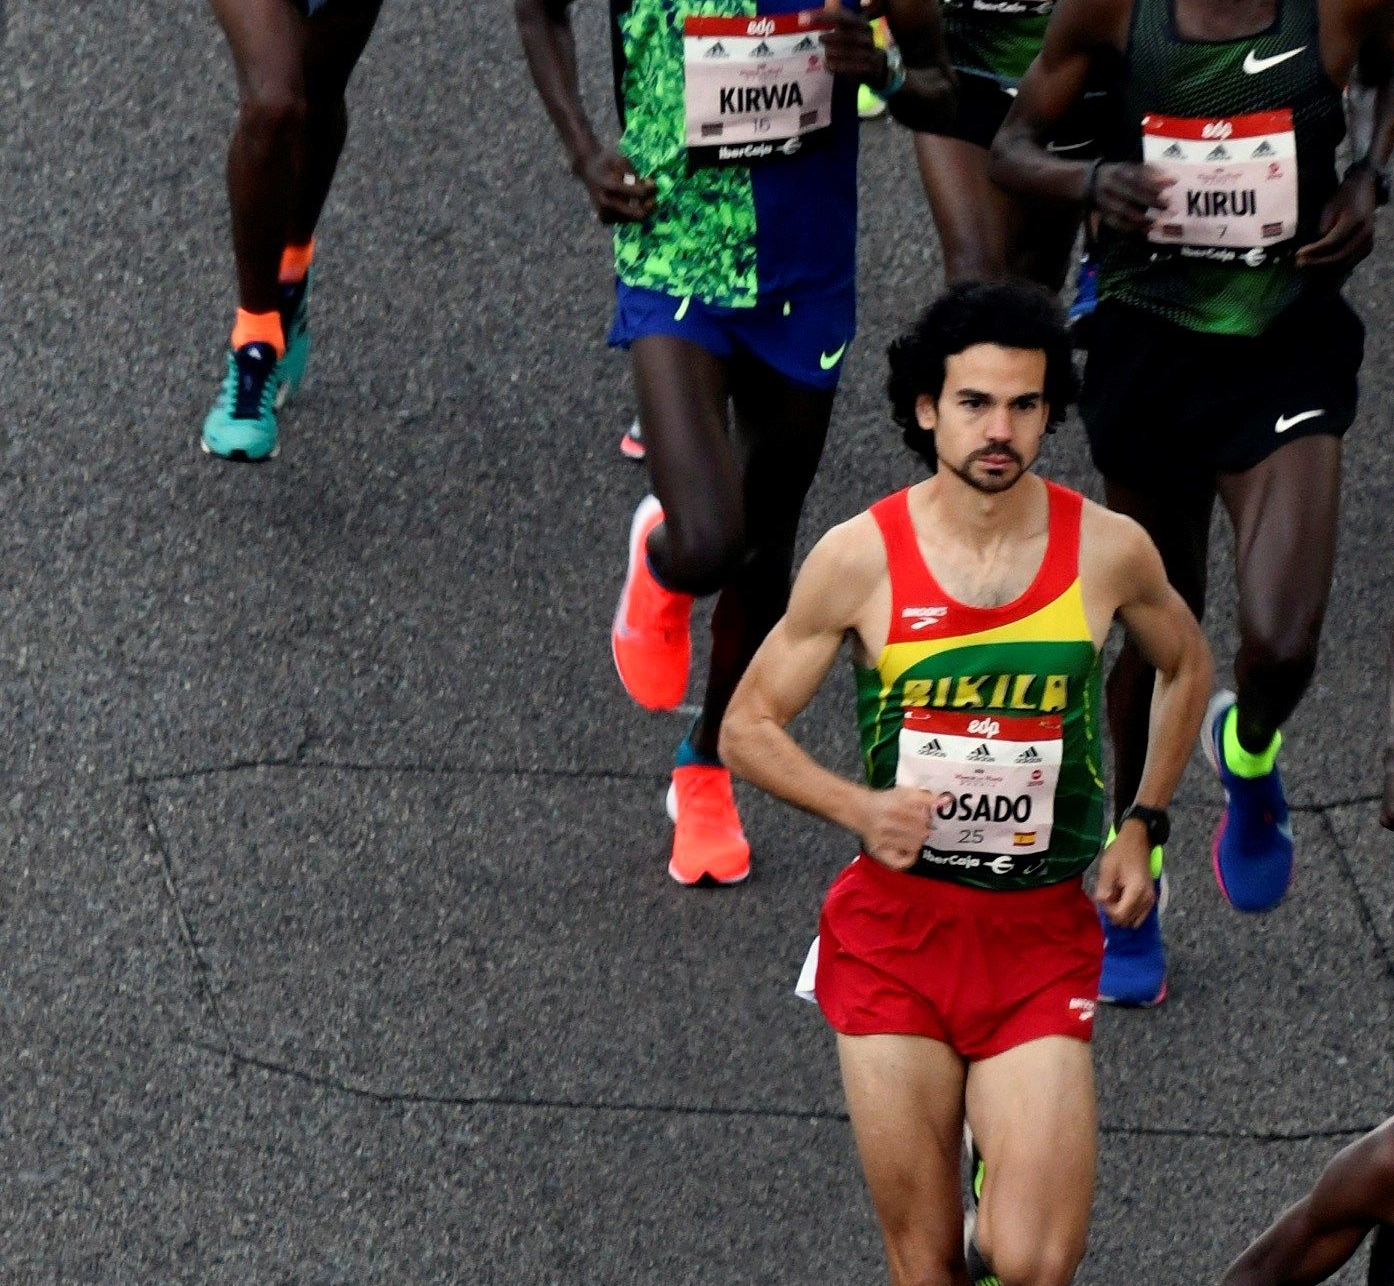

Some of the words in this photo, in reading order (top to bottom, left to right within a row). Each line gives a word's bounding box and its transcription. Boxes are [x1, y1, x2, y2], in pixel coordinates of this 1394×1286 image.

[746, 18, 776, 38] edp
[720, 81, 804, 115] KIRWA
[1186, 189, 1257, 217] KIRUI
[901, 674, 1069, 712] BIKILA
[967, 718, 1000, 738] edp
[957, 829, 985, 844] 25
